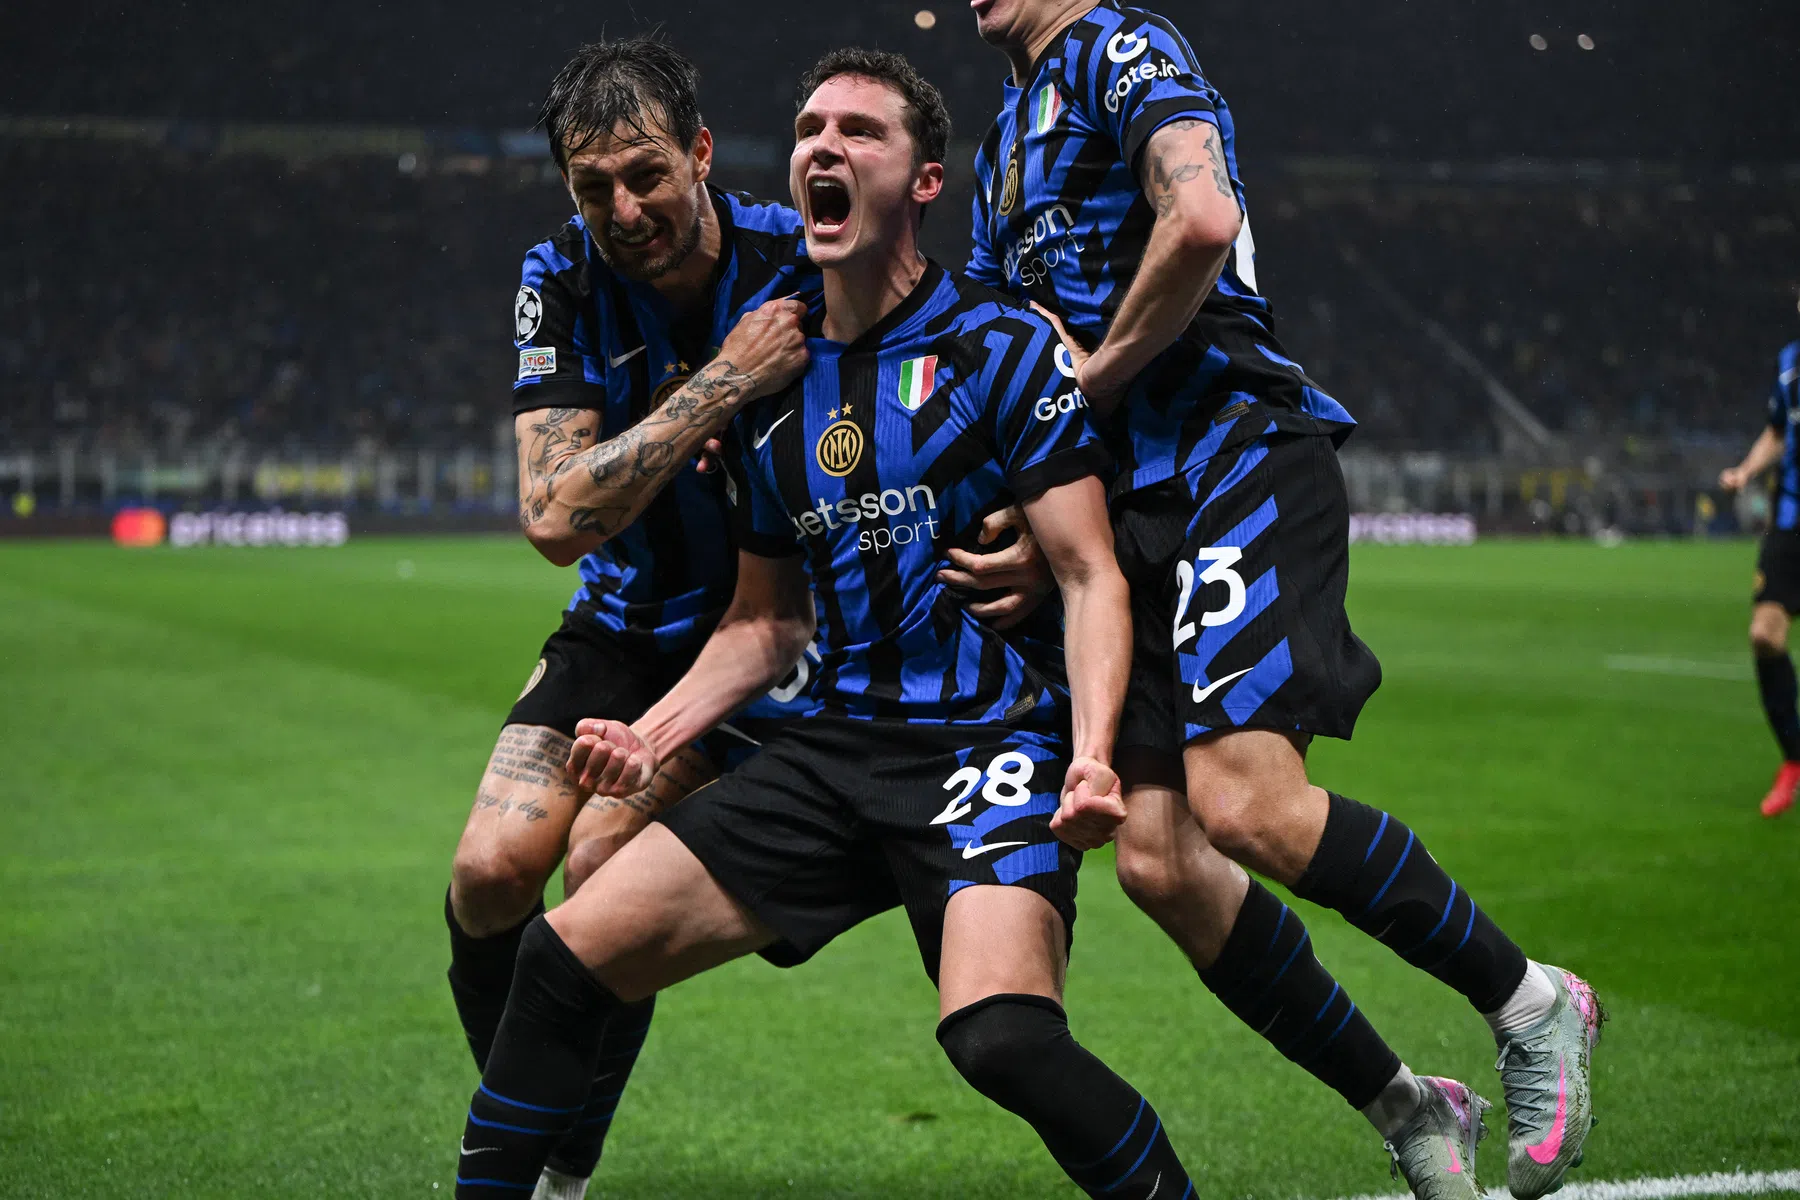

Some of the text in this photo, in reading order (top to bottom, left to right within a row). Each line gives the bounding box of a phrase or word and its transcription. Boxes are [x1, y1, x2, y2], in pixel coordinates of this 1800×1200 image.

[1001, 204, 1075, 282] etsson
[1020, 230, 1085, 286] sport
[1034, 387, 1089, 421] Gat
[858, 515, 940, 554] sport
[1173, 546, 1246, 652] 23
[929, 751, 1034, 825] 28
